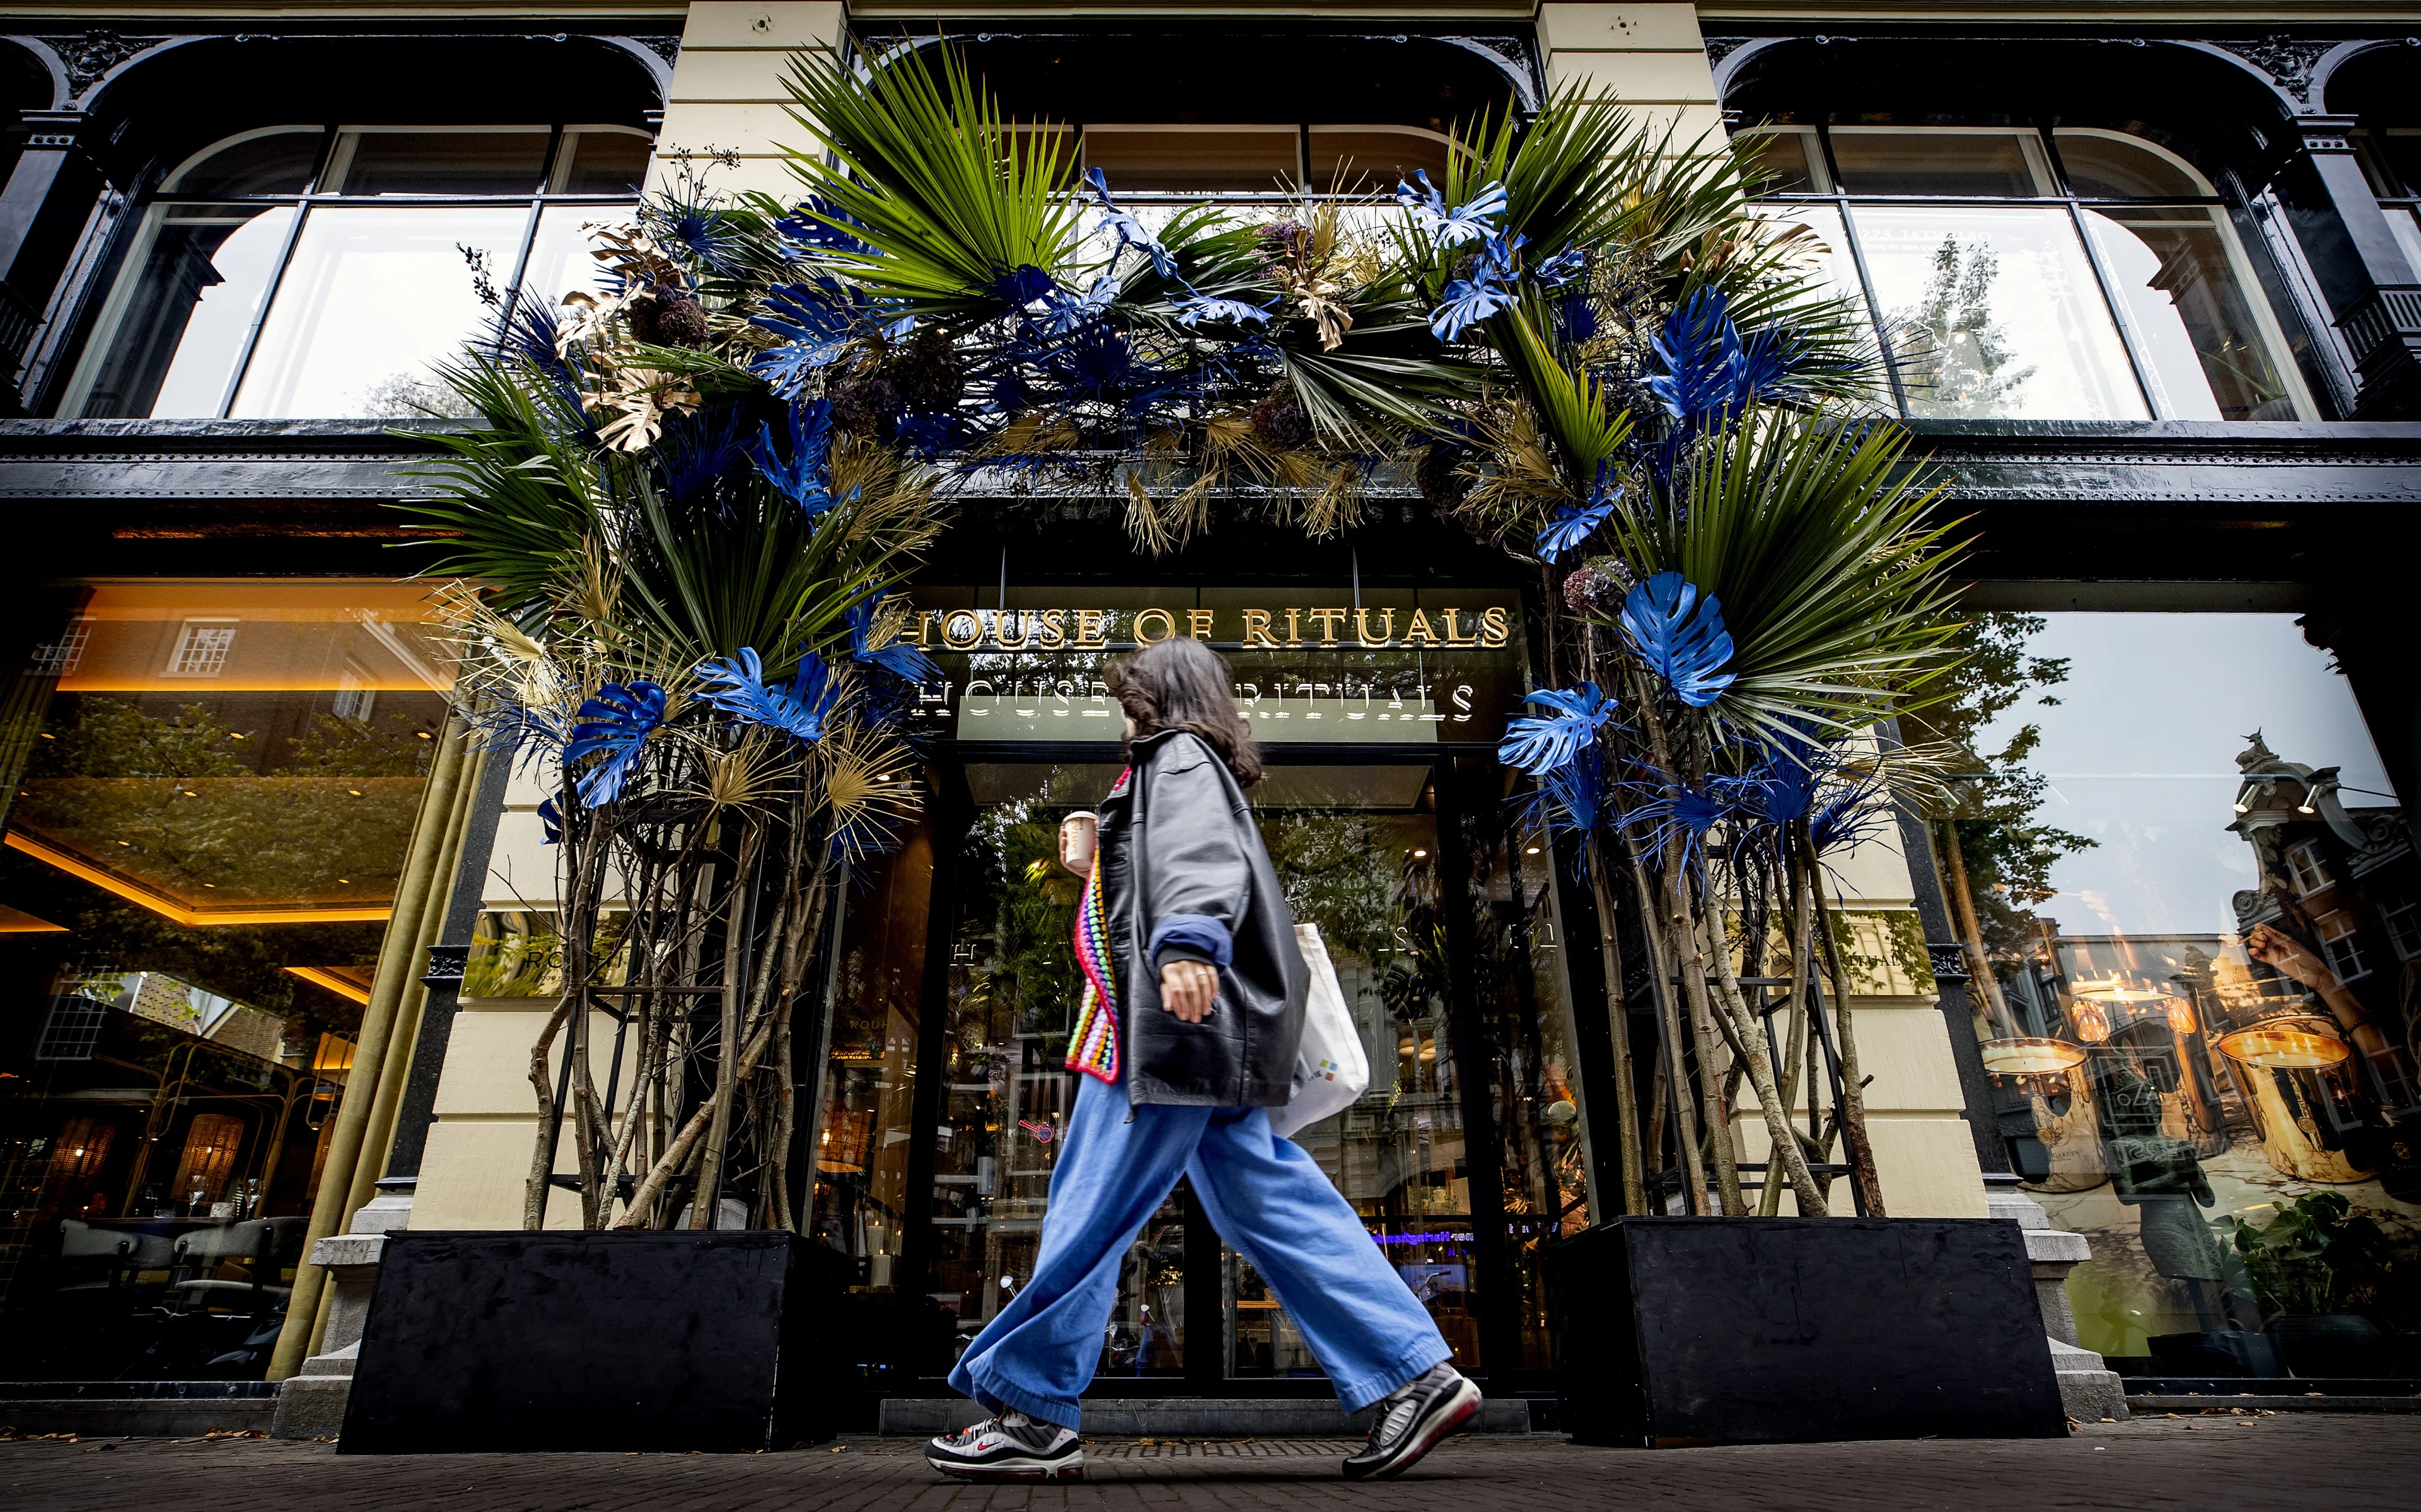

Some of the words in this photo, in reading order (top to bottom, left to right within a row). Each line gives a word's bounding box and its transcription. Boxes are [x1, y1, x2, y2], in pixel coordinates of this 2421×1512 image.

[900, 609, 1106, 650] HOUSE
[1132, 608, 1214, 647] OF
[1241, 607, 1509, 649] RITUALS
[526, 952, 623, 967] ROHI
[1838, 954, 1909, 966] RITUALS
